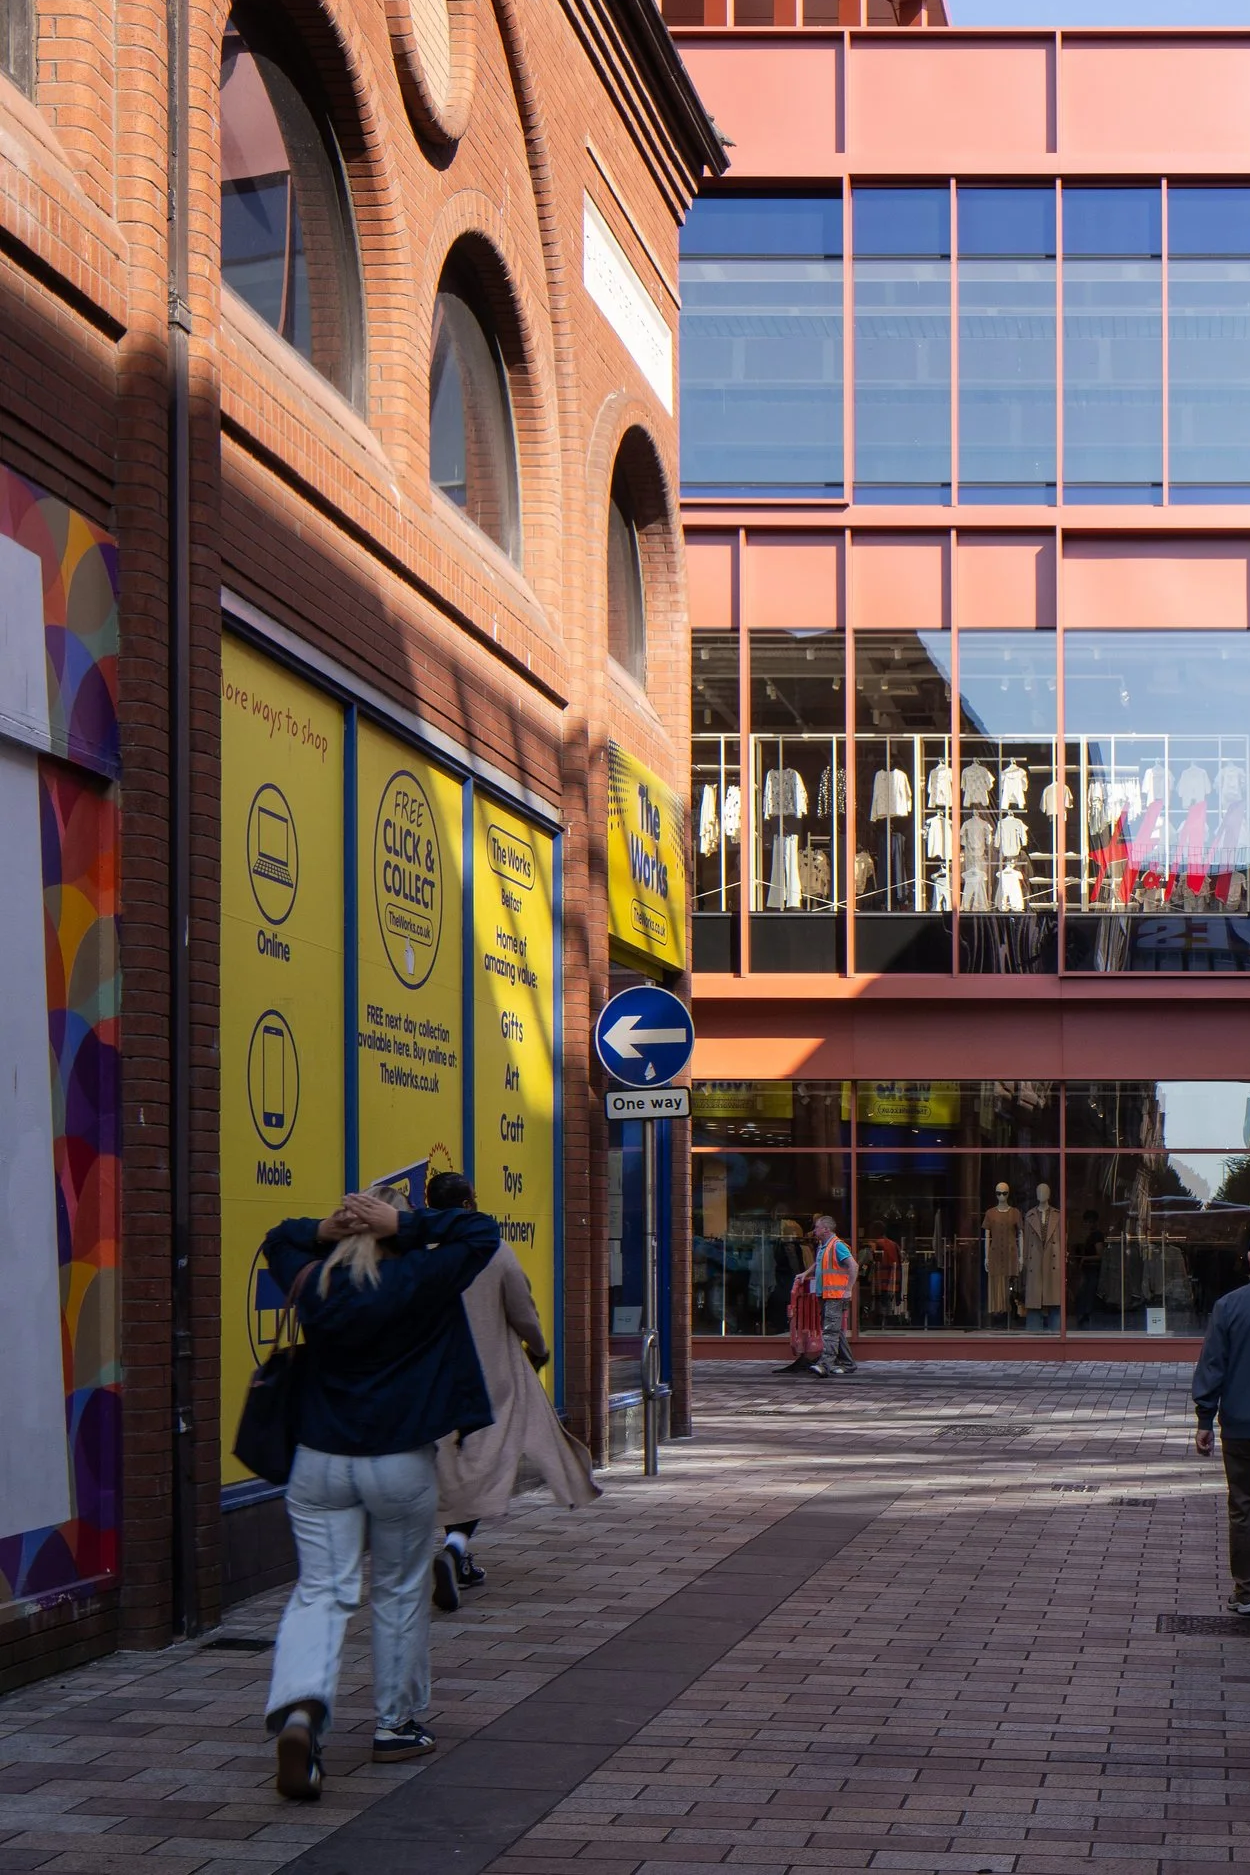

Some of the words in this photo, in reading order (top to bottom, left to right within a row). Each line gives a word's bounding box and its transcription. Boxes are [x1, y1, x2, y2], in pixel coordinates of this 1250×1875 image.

[252, 693, 282, 739] ways
[286, 708, 298, 737] to
[302, 718, 328, 763] shop
[394, 790, 424, 828] FREE
[637, 782, 661, 843] The
[383, 818, 422, 868] CLICK
[425, 839, 435, 874] &
[492, 837, 507, 866] The
[508, 846, 531, 879] Works
[629, 829, 669, 900] Works
[383, 860, 436, 911] COLLECT
[501, 888, 522, 914] Belfast
[388, 910, 431, 940] TheWorks.co.uk
[633, 905, 666, 938] TheWorks.co.uk
[257, 929, 290, 963] Online
[496, 925, 518, 955] Home
[519, 936, 527, 958] of
[484, 952, 516, 986] amazing
[517, 963, 538, 989] value:
[366, 1004, 384, 1027] FREE
[385, 1013, 402, 1031] next
[403, 1013, 417, 1039] day
[418, 1019, 450, 1043] collection
[501, 1010, 524, 1043] Gifts
[357, 1030, 392, 1054] available
[393, 1035, 412, 1057] here.
[413, 1041, 427, 1066] Buy
[427, 1045, 447, 1067] online
[448, 1051, 458, 1068] at:
[380, 1062, 440, 1094] TheWorks.co.uk
[505, 1063, 520, 1092] Art
[613, 1097, 645, 1111] One
[650, 1097, 682, 1111] way
[500, 1113, 525, 1143] Craft
[256, 1160, 292, 1187] Mobile
[503, 1165, 523, 1201] Toys
